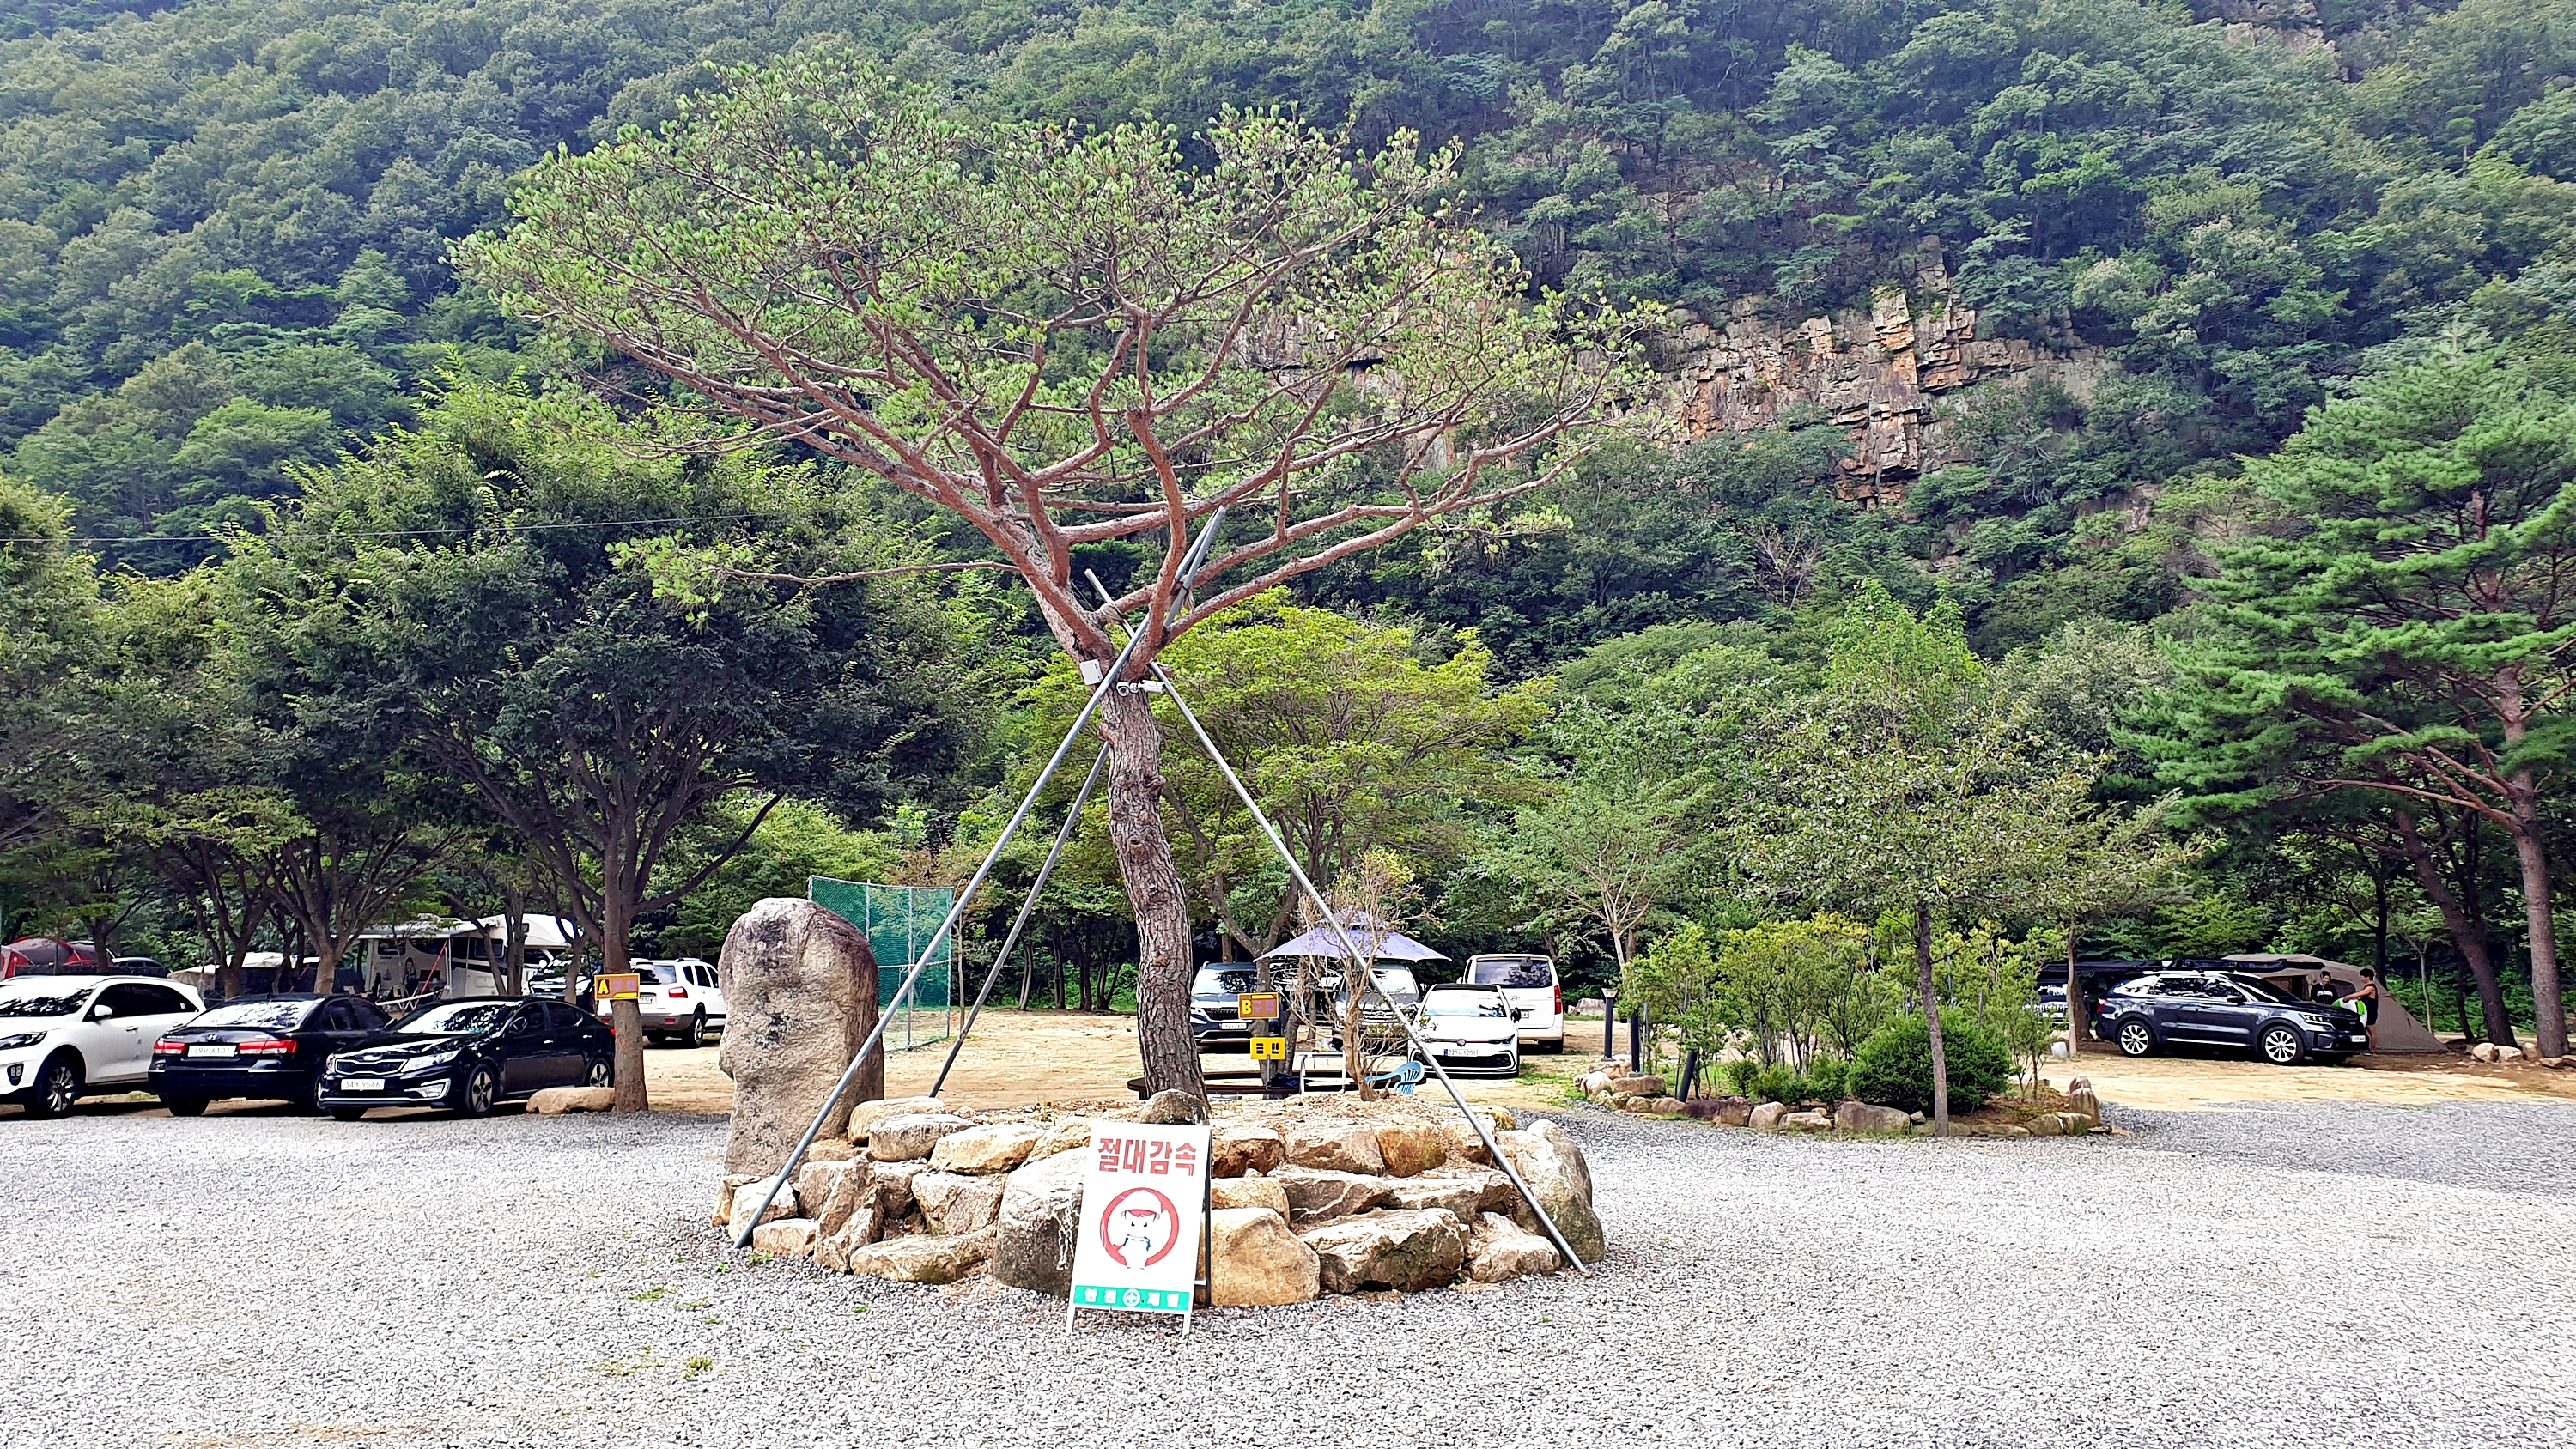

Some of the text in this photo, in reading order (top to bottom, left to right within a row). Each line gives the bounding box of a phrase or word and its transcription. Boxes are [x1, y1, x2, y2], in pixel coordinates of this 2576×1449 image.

[598, 979, 610, 994] A
[1242, 999, 1252, 1015] B
[1098, 1138, 1196, 1176] 절대감속
